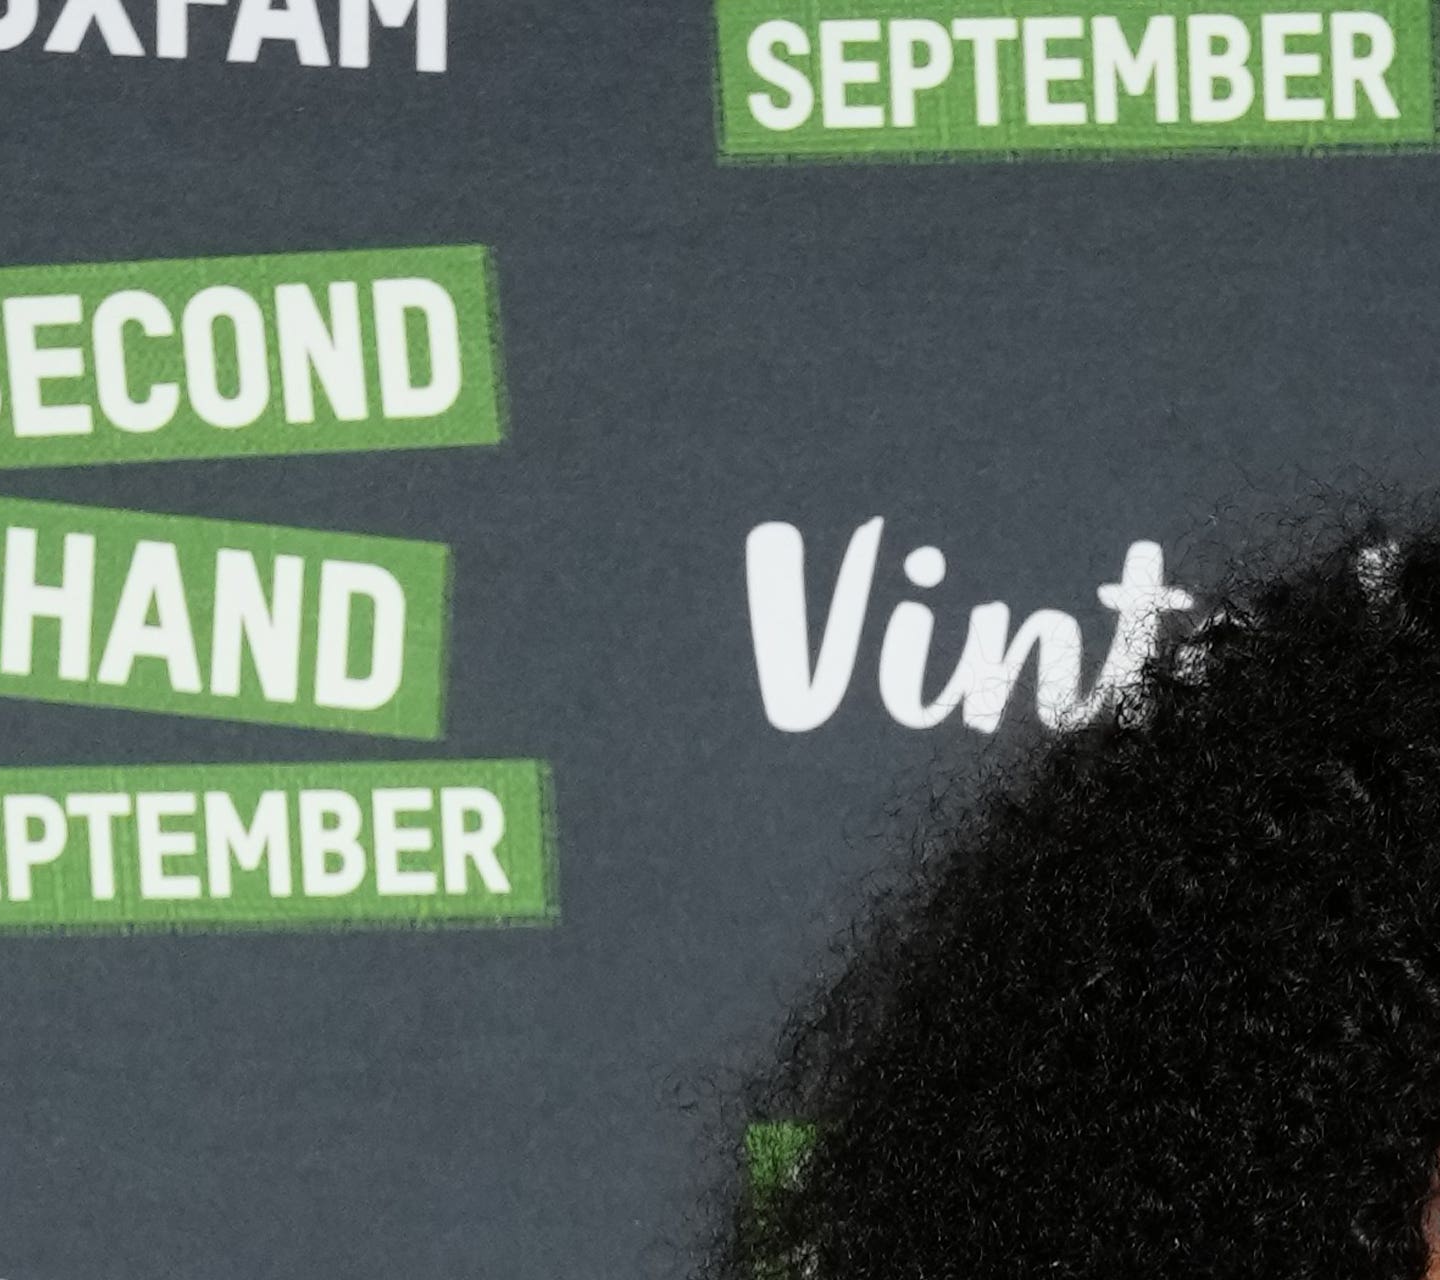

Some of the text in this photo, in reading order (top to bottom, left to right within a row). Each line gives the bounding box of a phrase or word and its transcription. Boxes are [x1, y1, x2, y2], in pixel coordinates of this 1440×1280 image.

[747, 10, 1399, 130] SEPTEMBER
[0, 527, 406, 710] HAND
[746, 516, 1260, 734] Vint
